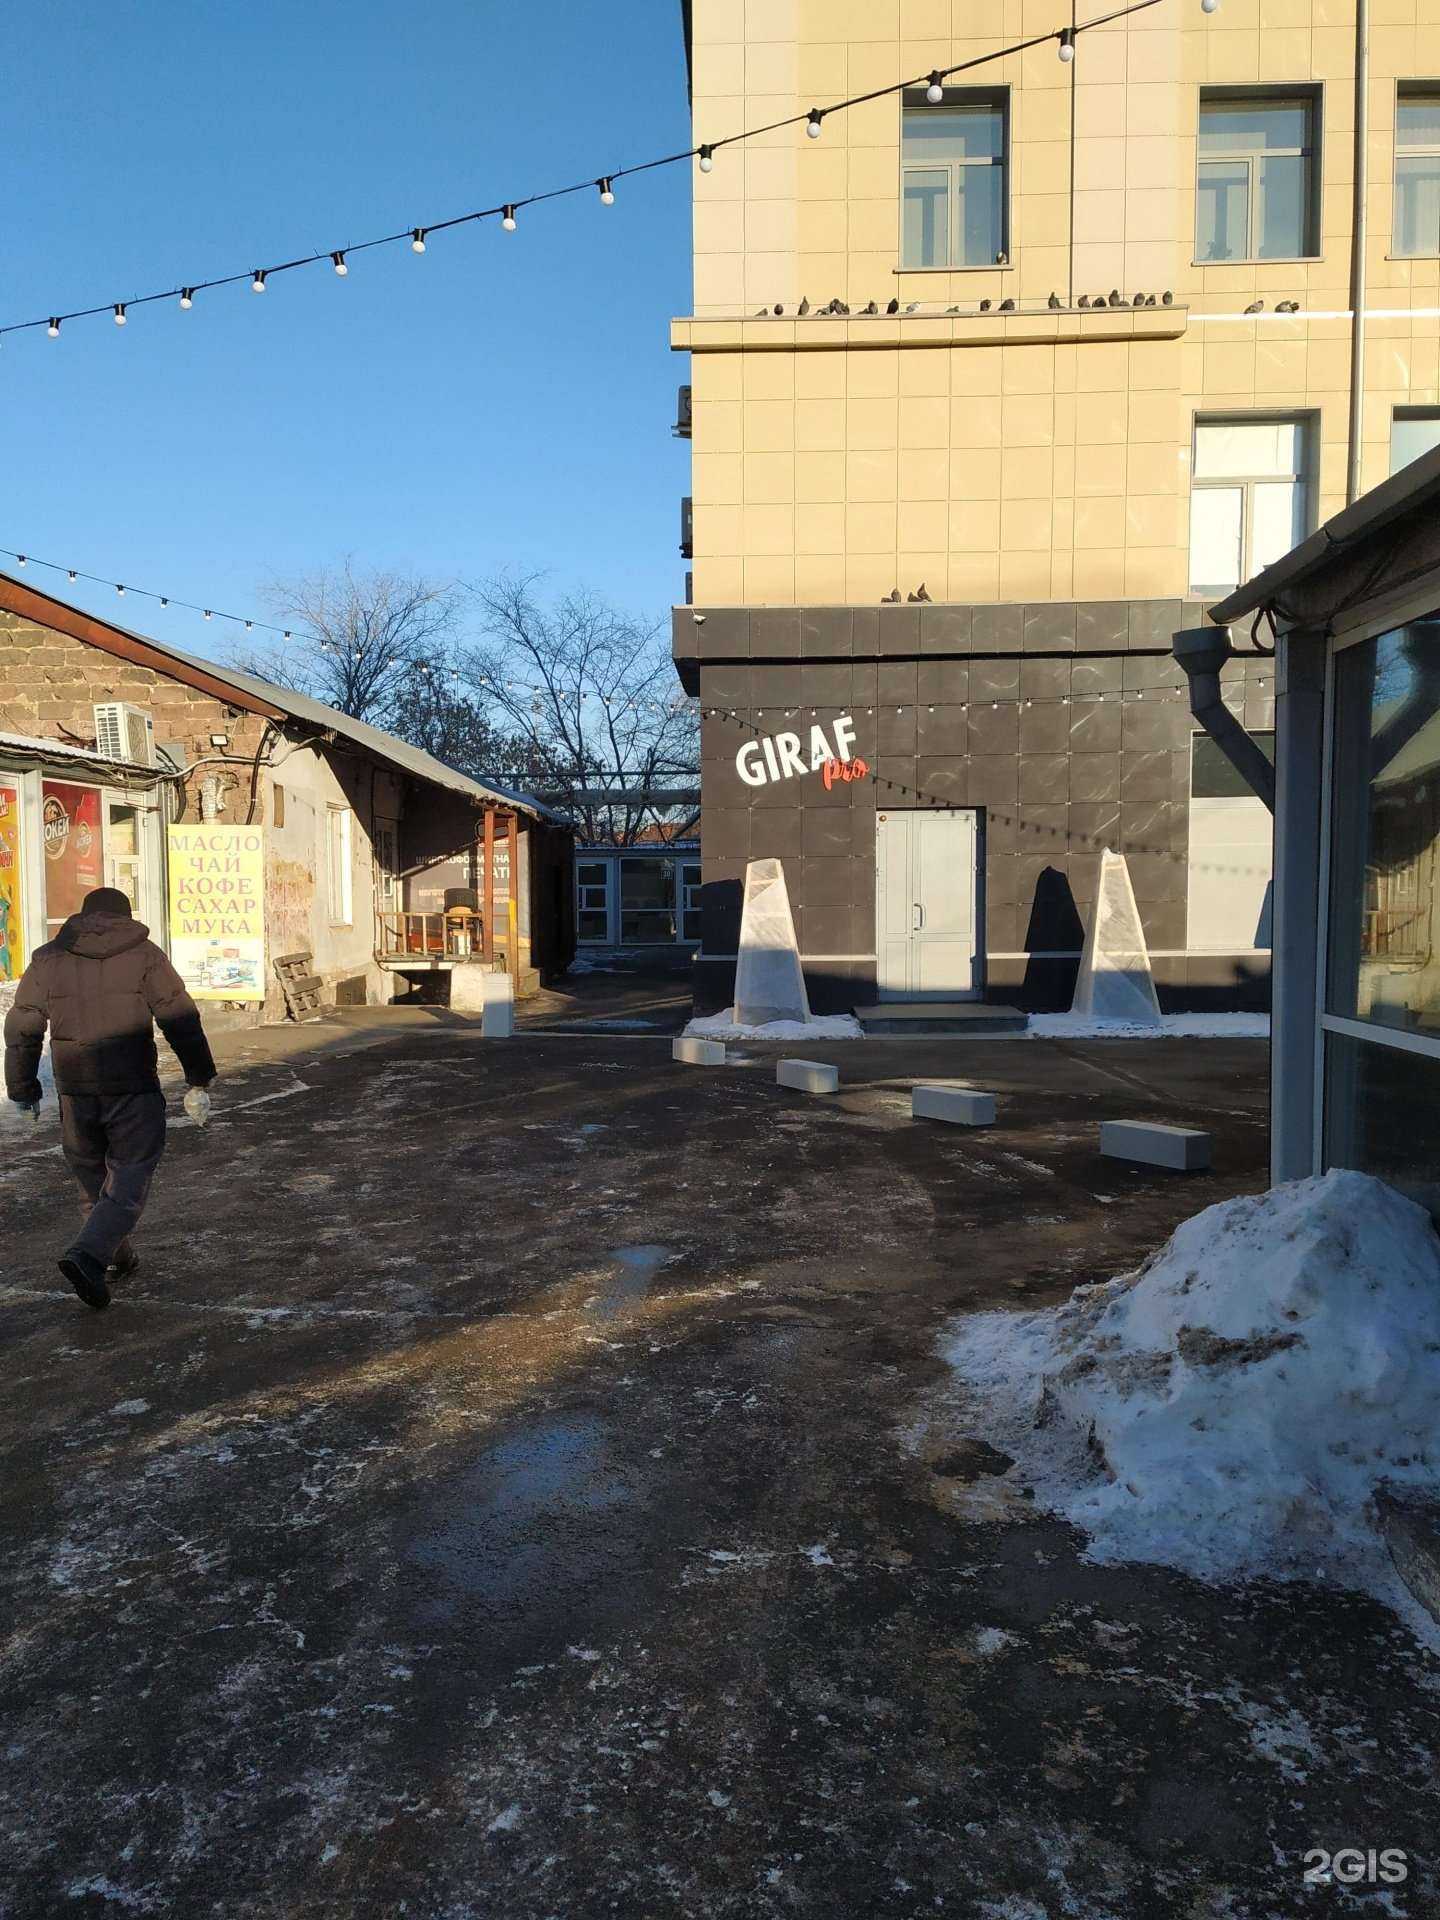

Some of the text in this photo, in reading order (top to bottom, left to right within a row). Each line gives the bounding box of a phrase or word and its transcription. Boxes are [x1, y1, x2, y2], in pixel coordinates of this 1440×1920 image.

[736, 716, 856, 786] GIRAF
[823, 758, 870, 791] pro
[169, 835, 260, 852] МАСЛО
[190, 852, 241, 873] ЧАЙ
[178, 877, 253, 895] КОФЕ
[177, 898, 256, 914] САХАР
[182, 918, 251, 934] МУКА
